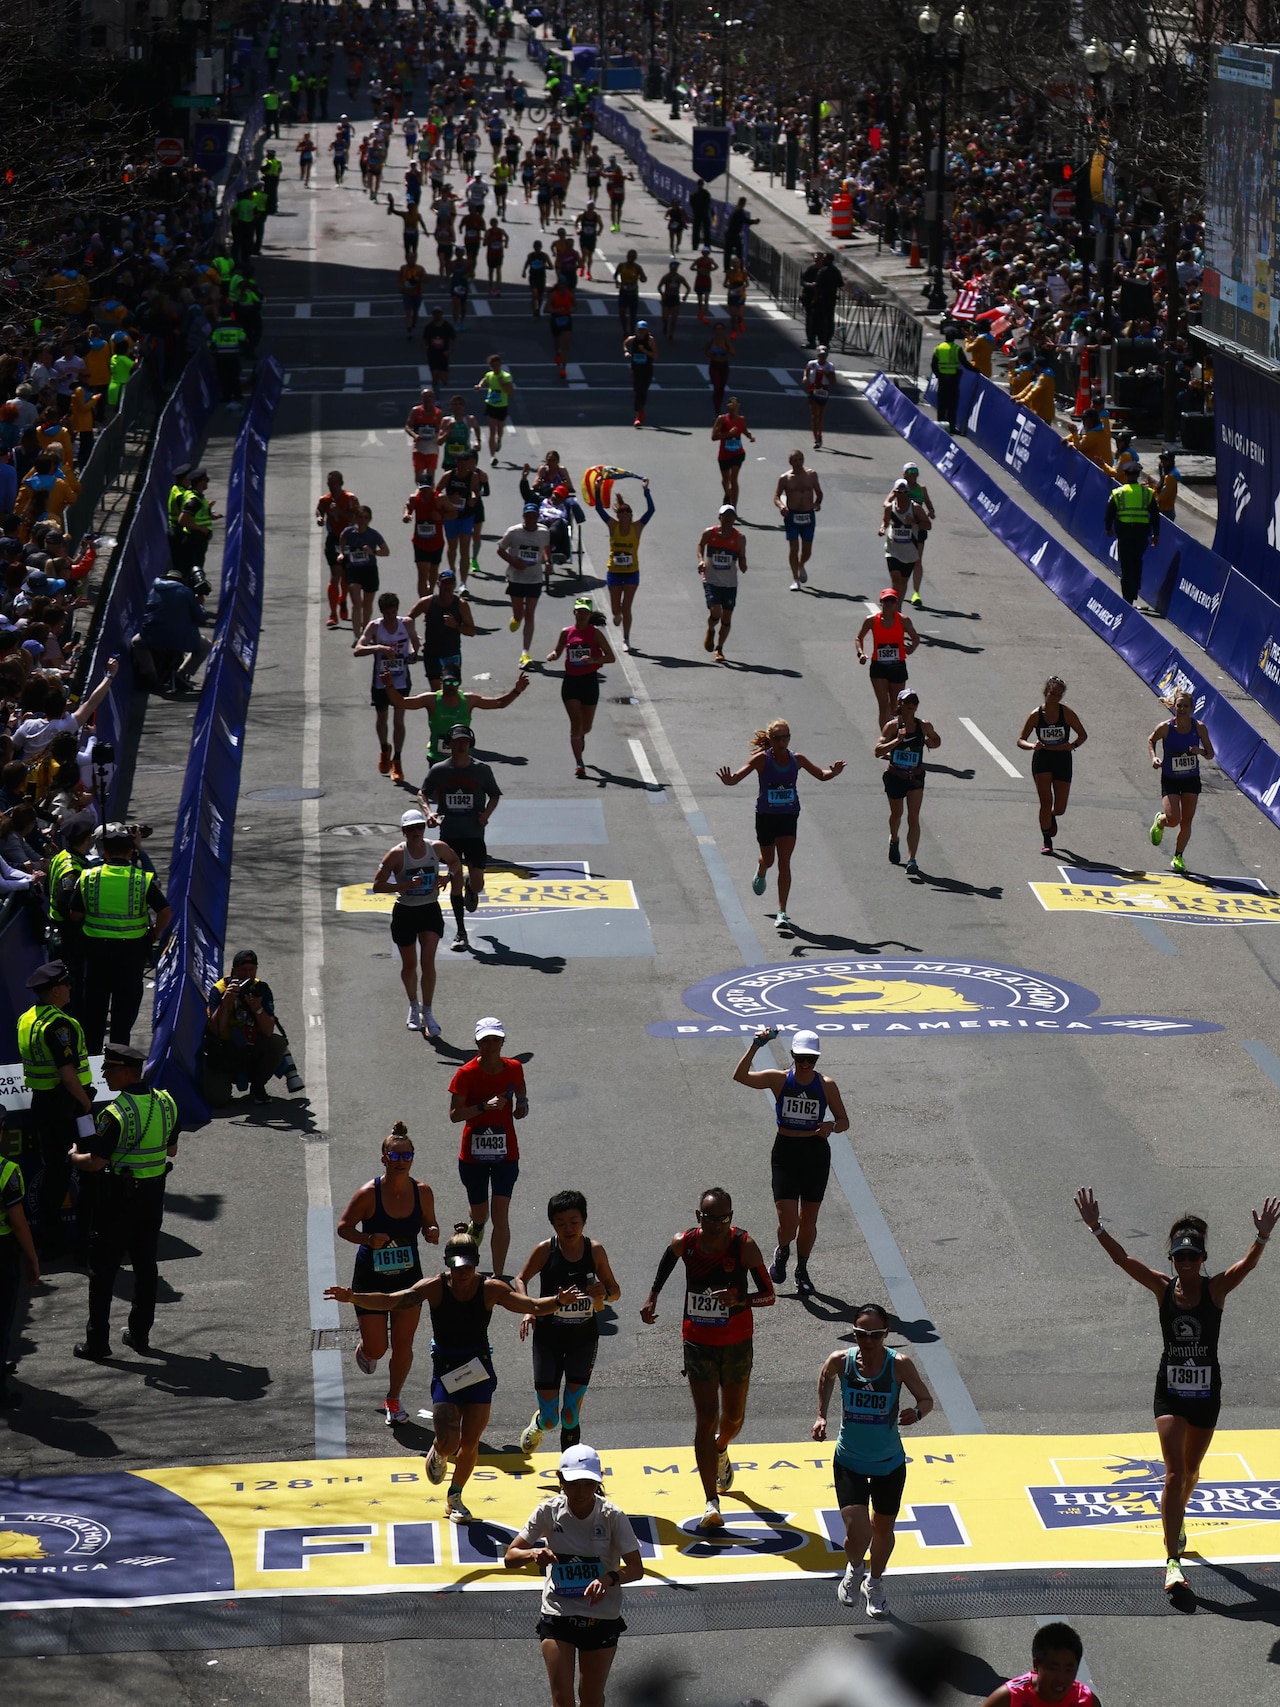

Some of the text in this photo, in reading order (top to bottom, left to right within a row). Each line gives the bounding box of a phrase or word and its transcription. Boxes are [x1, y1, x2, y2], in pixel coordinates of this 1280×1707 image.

[1043, 728, 1063, 738] 15425
[1174, 757, 1195, 768] 14815
[726, 962, 1058, 1015] 128TH BOSTON MARATHON
[676, 1020, 1095, 1033] BANK OF AMERICA
[0, 1076, 22, 1085] 28TH
[786, 1099, 817, 1114] 15162
[475, 1136, 504, 1150] 14433
[379, 1250, 409, 1265] 16199
[1168, 1341, 1208, 1357] Jennifer
[1172, 1368, 1206, 1384] 13911
[849, 1389, 886, 1411] 16203
[230, 1453, 956, 1492] 128TH BSTO MRATN
[24, 1514, 102, 1551] MARATHON
[0, 1563, 109, 1574] MERICA
[557, 1564, 599, 1581] 18488
